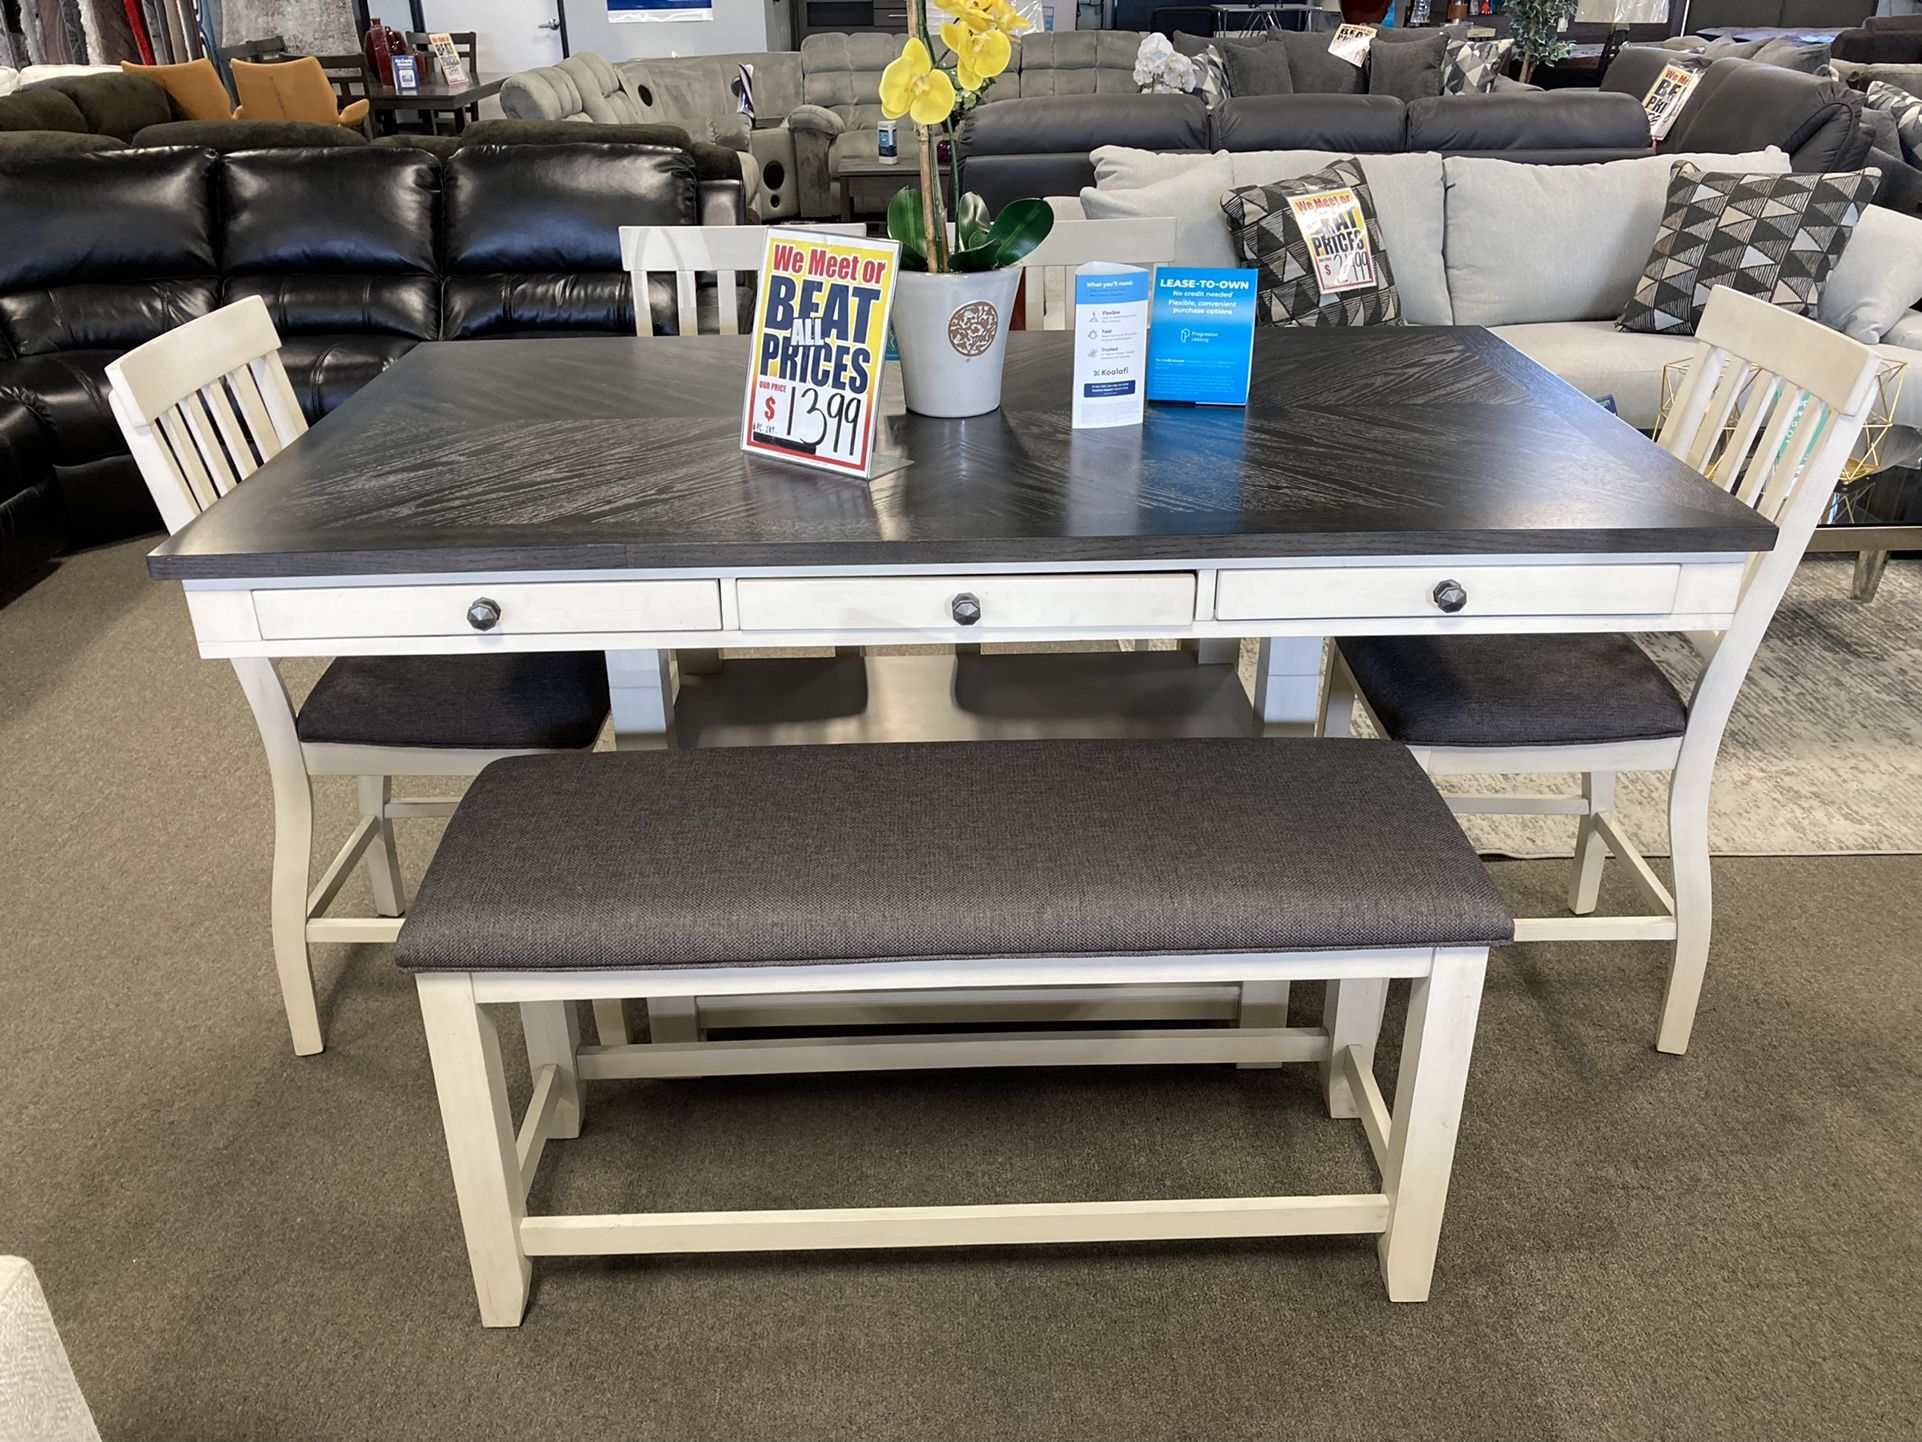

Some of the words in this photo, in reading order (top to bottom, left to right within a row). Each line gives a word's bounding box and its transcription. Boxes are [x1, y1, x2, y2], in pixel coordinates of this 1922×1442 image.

[1665, 69, 1679, 81] We
[1295, 201, 1313, 212] We
[1313, 195, 1337, 209] Meet
[1311, 229, 1364, 256] PRICES
[773, 244, 804, 274] We
[808, 249, 859, 281] Meet
[862, 260, 887, 284] or
[1324, 264, 1332, 276] $
[1160, 279, 1249, 290] LEASE-TO-OWN
[764, 274, 881, 345] BEAT
[790, 317, 825, 345] ALL
[759, 332, 871, 395] PRICES
[1101, 367, 1129, 376] Koalafi
[759, 380, 770, 390] OUR
[771, 382, 787, 394] PRICE
[764, 396, 776, 422] $
[786, 386, 862, 456] 1399
